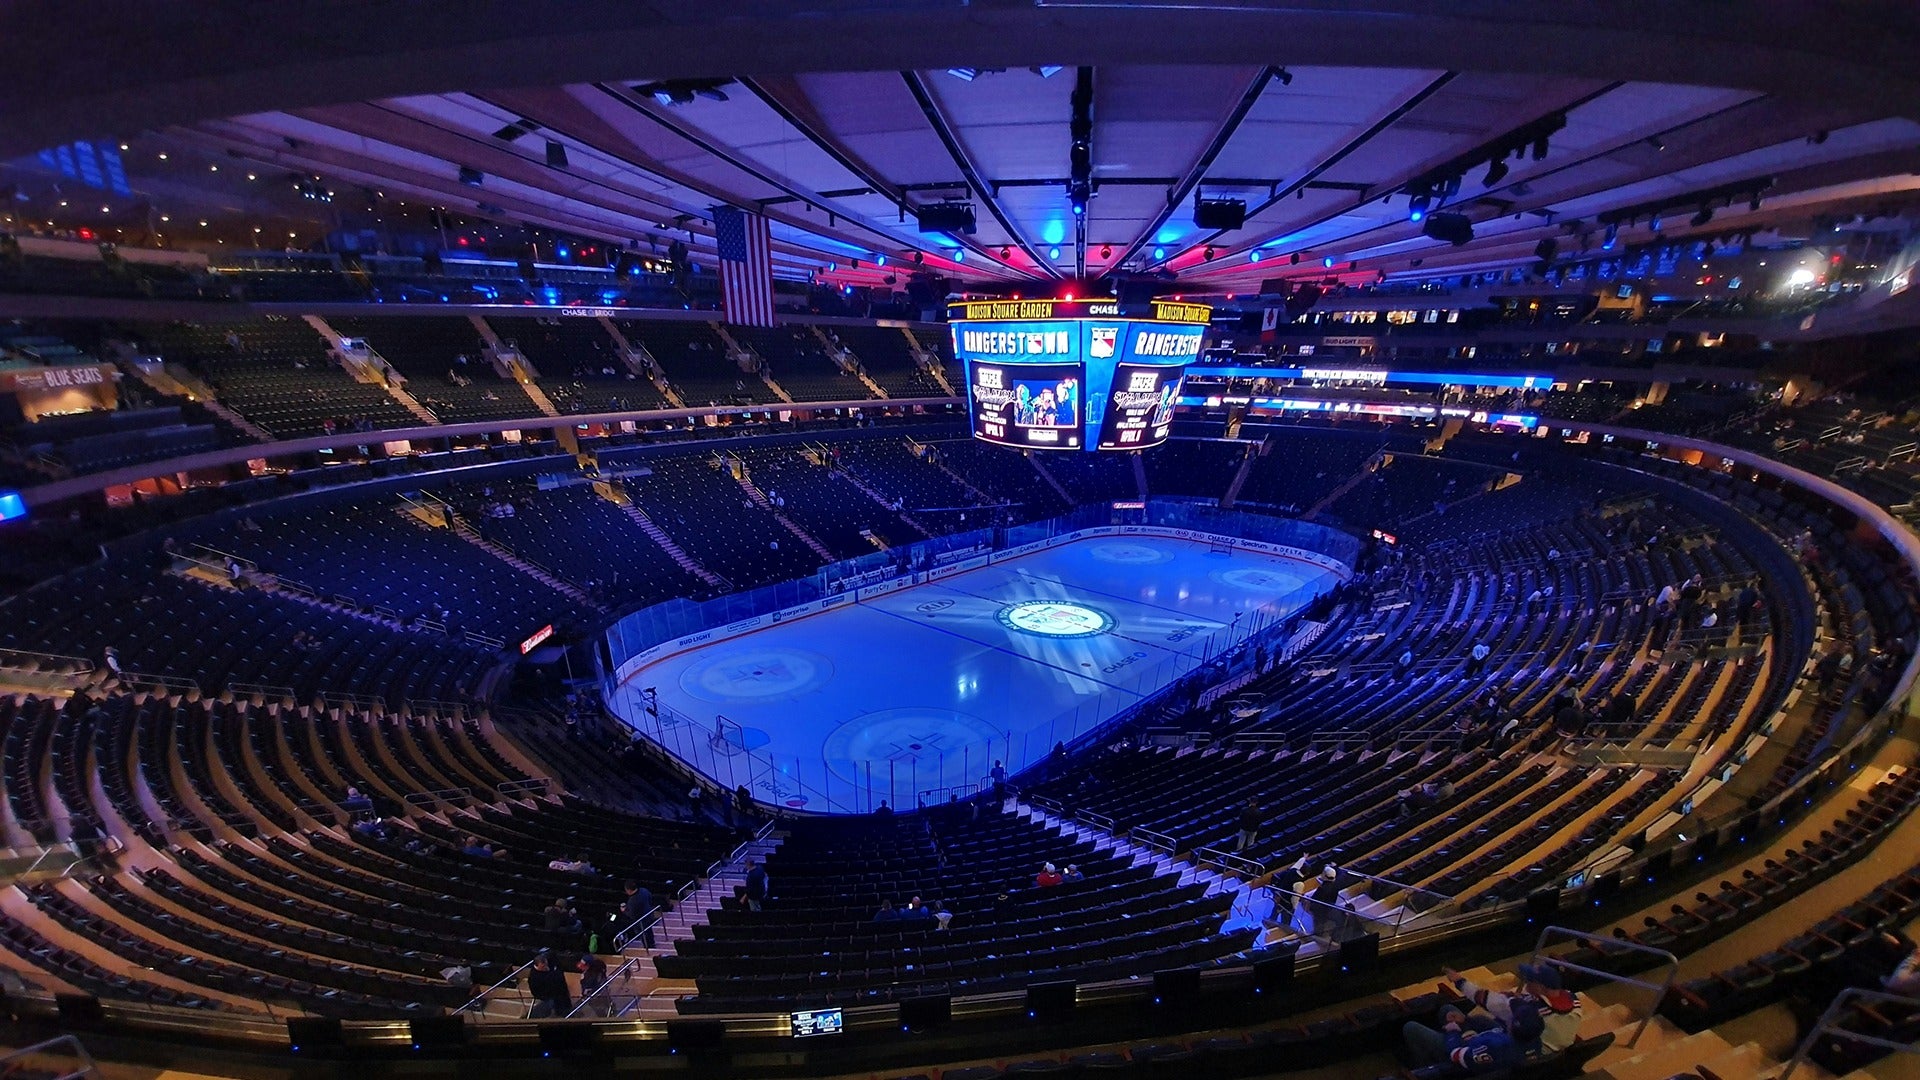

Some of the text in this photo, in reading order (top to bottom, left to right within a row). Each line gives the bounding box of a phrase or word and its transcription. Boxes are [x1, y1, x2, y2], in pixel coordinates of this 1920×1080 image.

[966, 302, 1052, 319] MADISON SQUARE GARDEN
[1156, 304, 1184, 320] MADISON
[44, 370, 73, 387] BLUE
[72, 367, 103, 385] SEATS
[1241, 541, 1268, 549] Spectrum
[1280, 547, 1302, 555] DELTA
[921, 601, 951, 610] KIA
[679, 633, 711, 647] BUD LIGHT
[1103, 655, 1138, 674] CHASE
